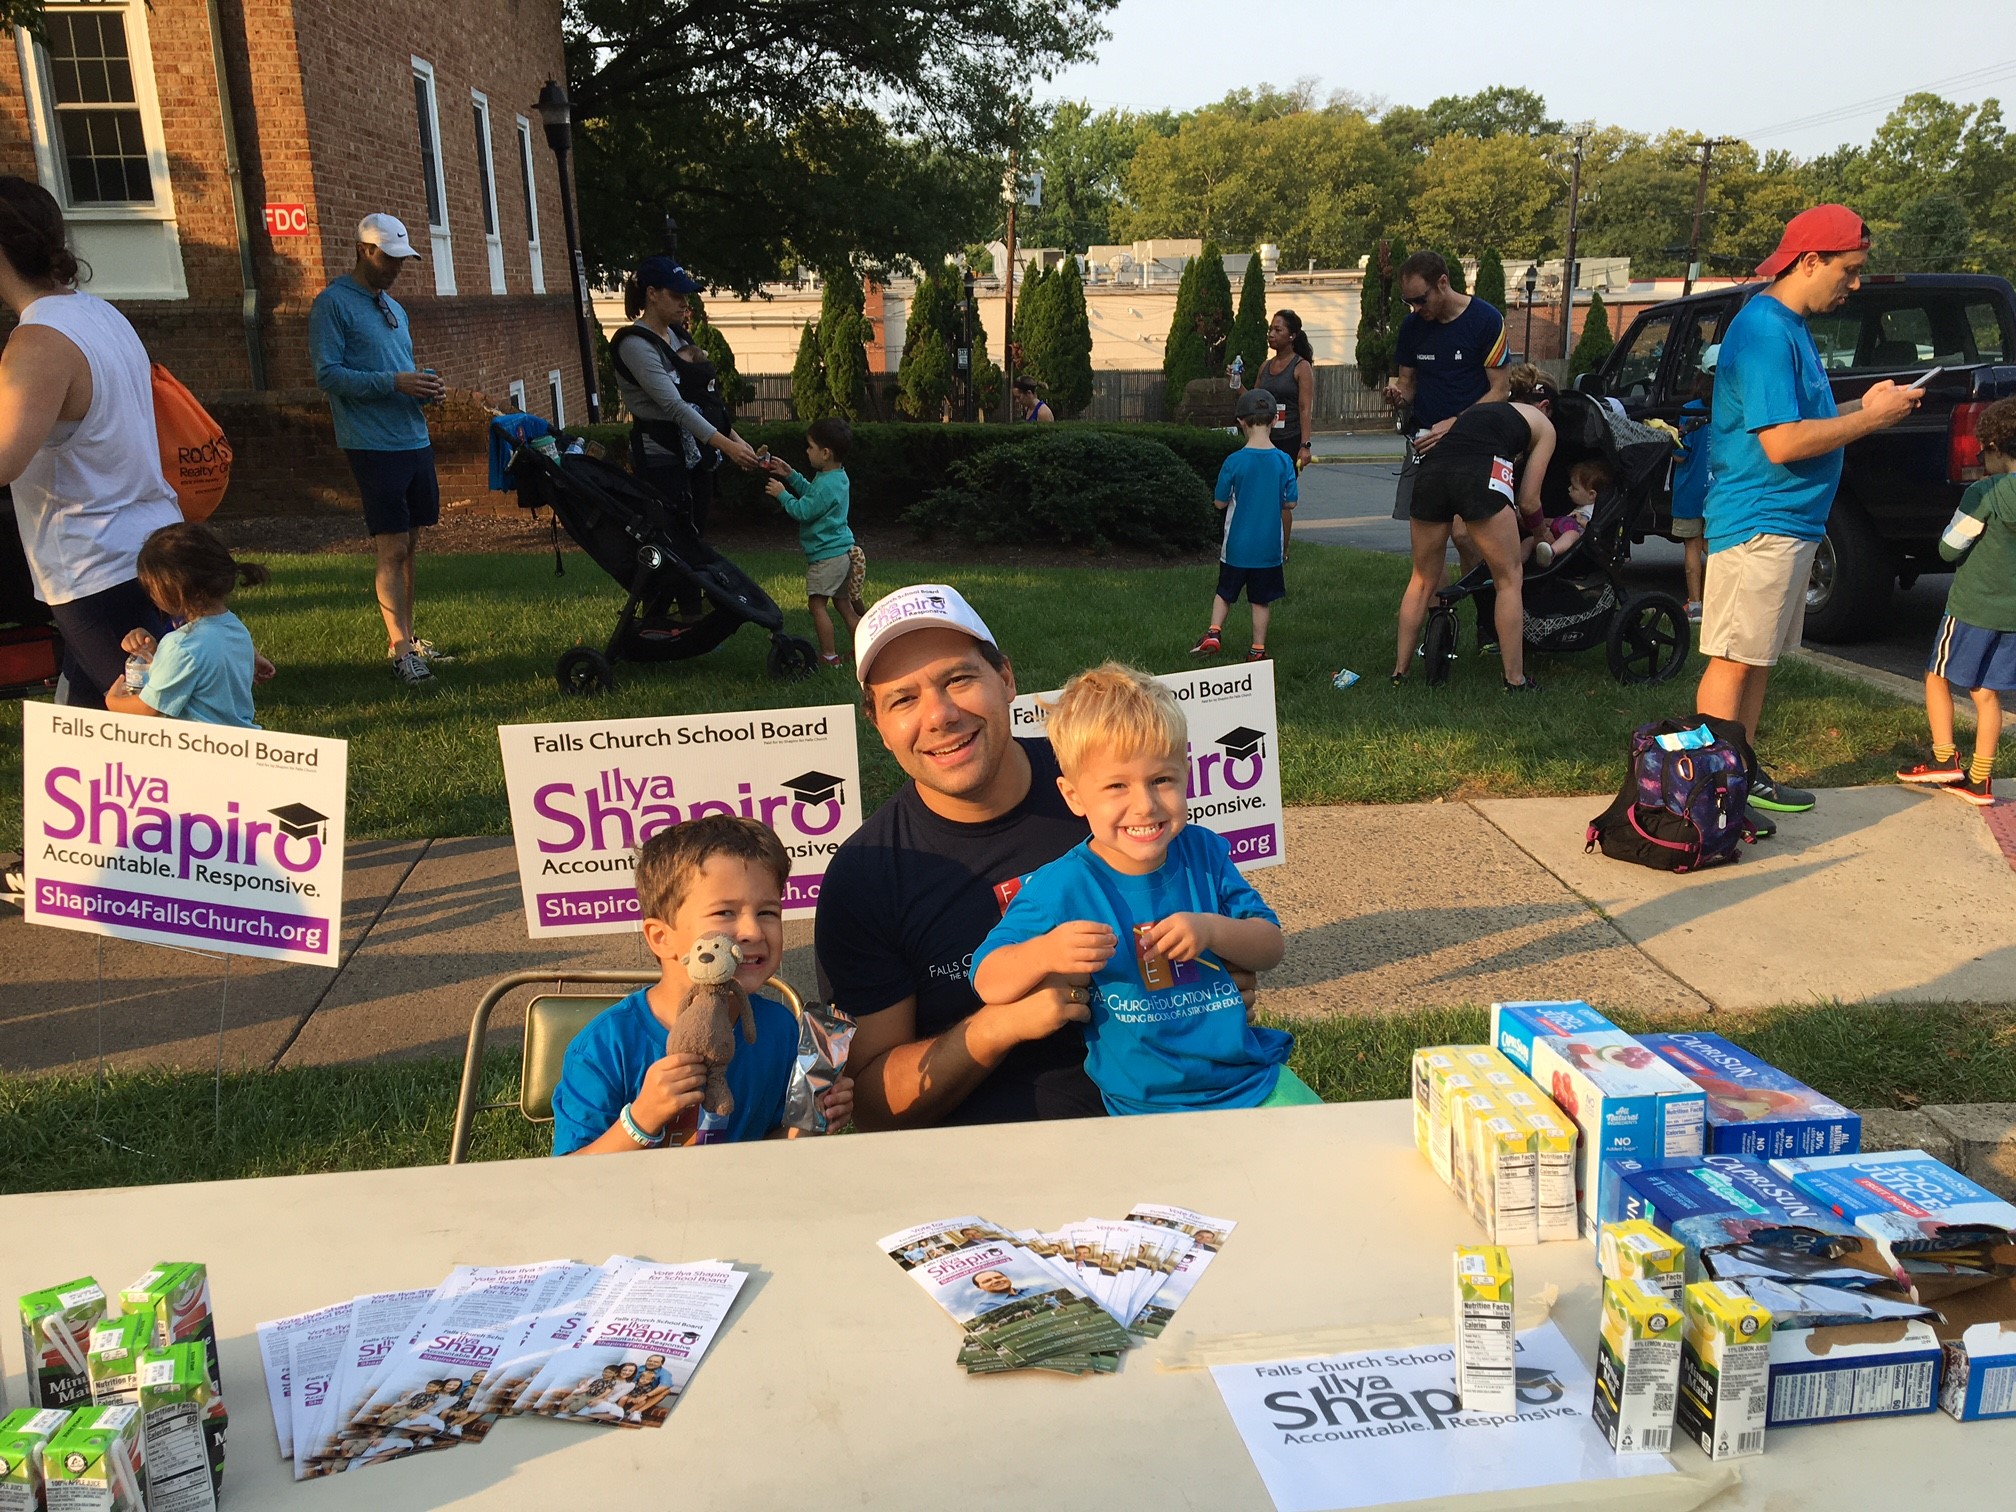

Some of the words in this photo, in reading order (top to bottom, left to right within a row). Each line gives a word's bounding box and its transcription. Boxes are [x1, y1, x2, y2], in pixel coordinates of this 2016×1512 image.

[261, 208, 306, 231] FDC
[868, 597, 945, 637] Shapiro
[1200, 673, 1252, 698] Board
[52, 716, 94, 738] Falls
[100, 723, 172, 748] Church
[178, 733, 249, 759] School
[256, 741, 318, 767] Board
[533, 734, 584, 753] Falls
[589, 728, 671, 750] Church
[677, 722, 755, 745] School
[761, 717, 828, 739] Board
[104, 761, 169, 808] Ilya
[600, 767, 675, 811] Ilya
[533, 782, 842, 854] Shairo
[1187, 796, 1266, 825] sponsive.
[43, 766, 322, 880] Shapiro
[43, 844, 176, 878] Accountable.
[196, 864, 320, 898] Responsive.
[542, 854, 635, 876] Account
[41, 885, 322, 948] Shapiro4FallsChurch.org
[545, 895, 641, 920] Shapiro
[929, 961, 960, 978] FALLS
[949, 972, 962, 981] THE
[1145, 959, 1160, 984] E
[1107, 994, 1155, 1012] CHURCH
[1152, 988, 1211, 1010] EDUCATION
[1213, 981, 1239, 999] FOU
[1188, 1002, 1222, 1016] STRONGER
[1223, 996, 1243, 1008] EDUC
[1614, 1137, 1631, 1146] NO
[1756, 1137, 1765, 1151] NO
[1785, 1136, 1794, 1149] NO
[1816, 1131, 1825, 1150] 30%
[1850, 1162, 1947, 1210] JUICE
[1884, 1165, 1960, 1201] 100%
[1861, 1179, 1890, 1196] FRUIT
[1890, 1193, 1922, 1216] PUNCH
[694, 1271, 730, 1279] Shapiro
[927, 1247, 1003, 1279] Shapiro
[1664, 1273, 1682, 1282] Facts
[1674, 1289, 1682, 1298] 80
[1464, 1302, 1491, 1310] Nutrition
[1492, 1303, 1510, 1311] Facts
[276, 1318, 301, 1326] Vote
[303, 1312, 322, 1320] Ilya
[294, 1312, 333, 1327] School
[307, 1327, 333, 1335] Vote
[628, 1321, 651, 1330] Ilya
[682, 1322, 704, 1330] Board
[1464, 1321, 1487, 1330] Calories
[1501, 1320, 1511, 1330] 80
[601, 1322, 697, 1346] Shapiro
[428, 1336, 501, 1358] Shapi
[1738, 1345, 1755, 1353] LEMON
[421, 1353, 491, 1367] Shapiro4FallsChur
[1255, 1365, 1302, 1378] Falls
[1306, 1358, 1382, 1375] Church
[1385, 1350, 1456, 1367] School
[49, 1376, 88, 1394] Minu
[96, 1377, 127, 1388] Nutrition
[1318, 1373, 1394, 1398] Ilya
[1684, 1356, 1714, 1396] Minute
[1894, 1365, 1902, 1389] Calories
[58, 1387, 89, 1404] Mai
[1687, 1373, 1709, 1404] Maid
[146, 1405, 176, 1420] Nutrition
[178, 1403, 196, 1412] Facts
[1264, 1383, 1563, 1431] Shapo
[147, 1426, 171, 1440] Calories
[187, 1415, 197, 1424] 80
[1284, 1421, 1431, 1445] Accountable.
[1450, 1404, 1582, 1429] Responsive.
